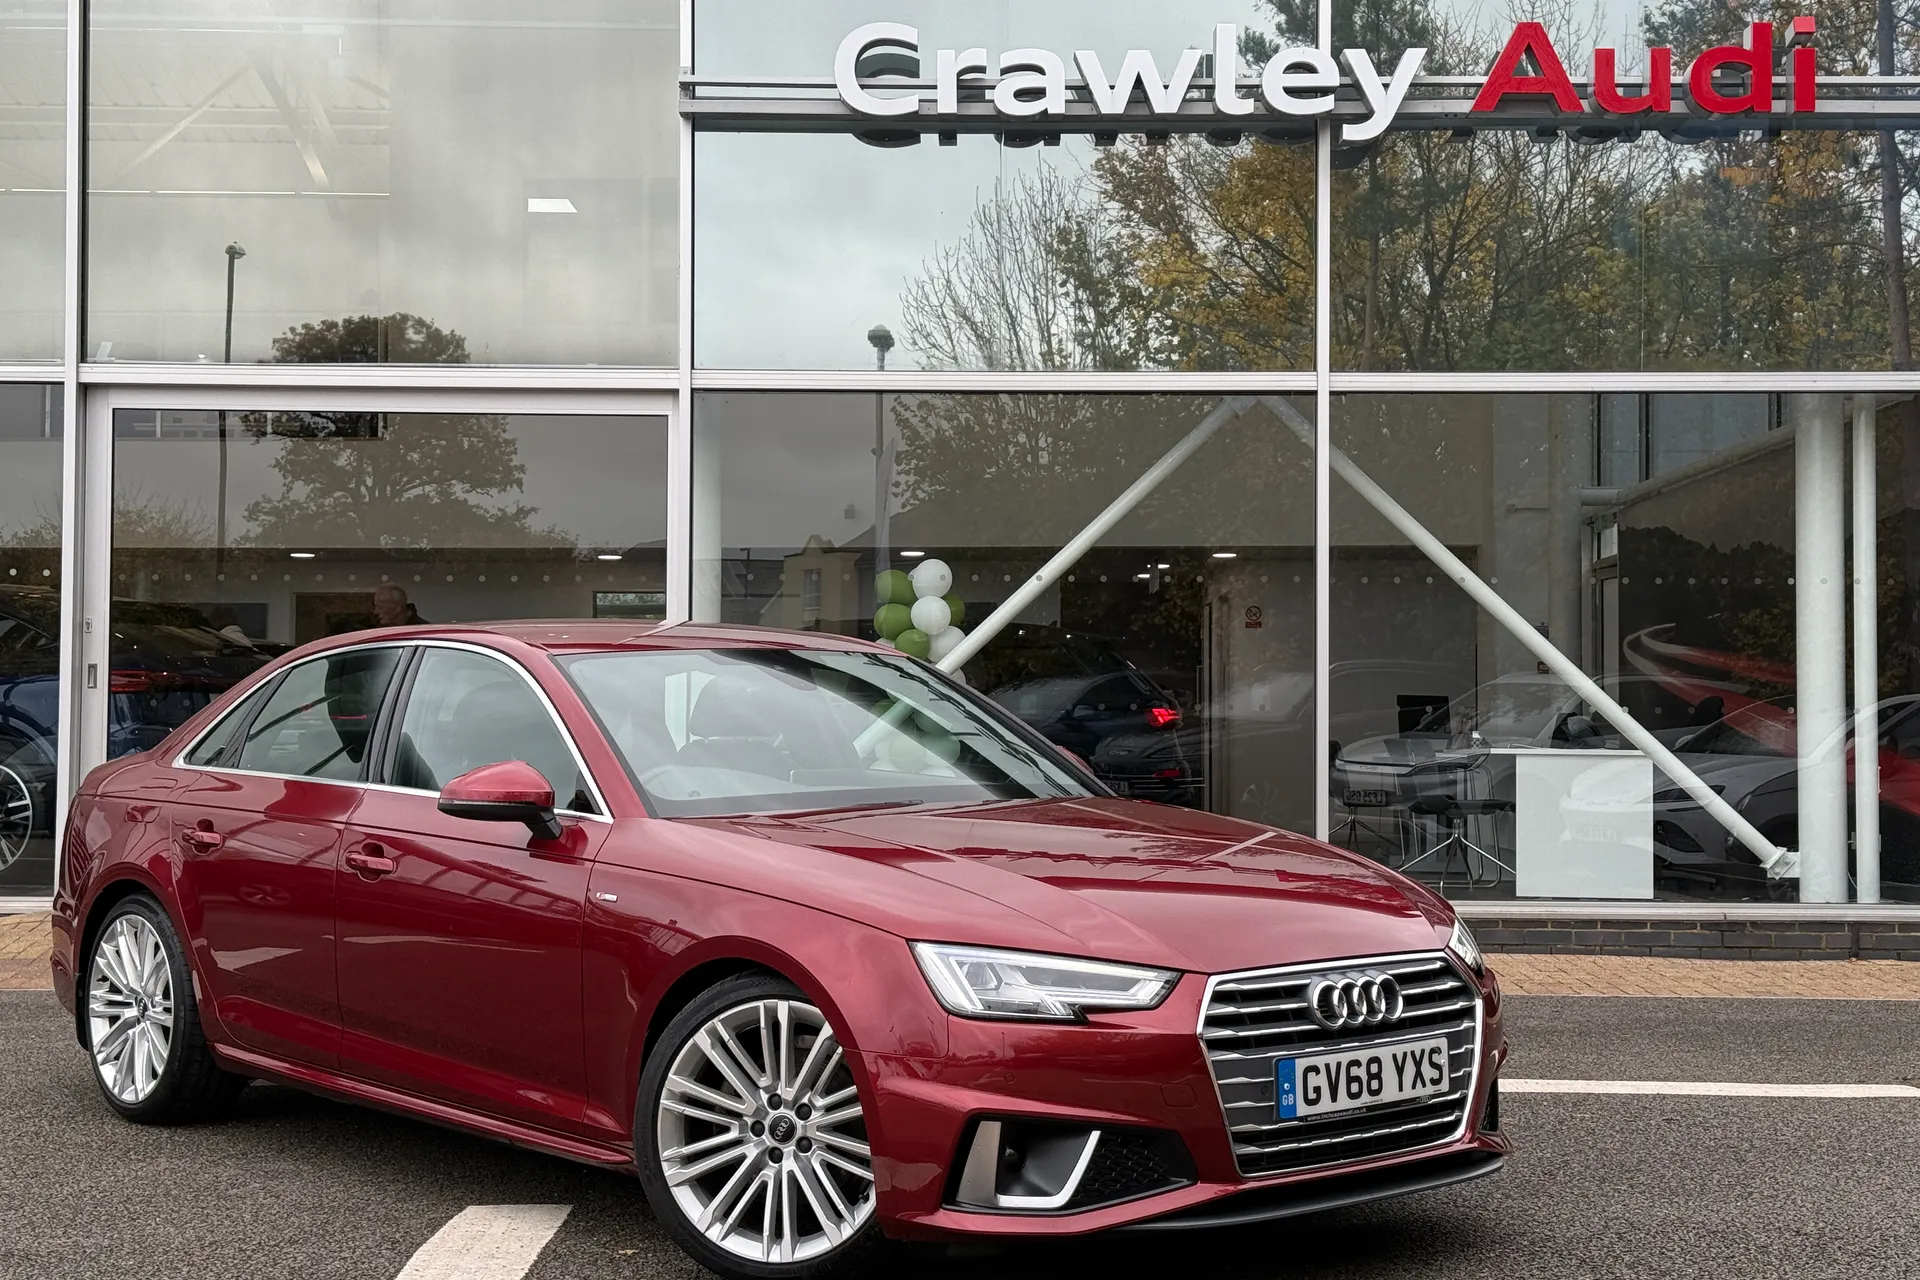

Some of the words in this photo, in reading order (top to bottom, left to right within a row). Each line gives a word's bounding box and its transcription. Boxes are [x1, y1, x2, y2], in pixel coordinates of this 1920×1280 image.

[834, 21, 1428, 142] Crawley
[1471, 16, 1816, 114] Audi
[1282, 1094, 1294, 1105] GB
[1302, 1055, 1384, 1107] GV68
[1391, 1046, 1444, 1093] YXS
